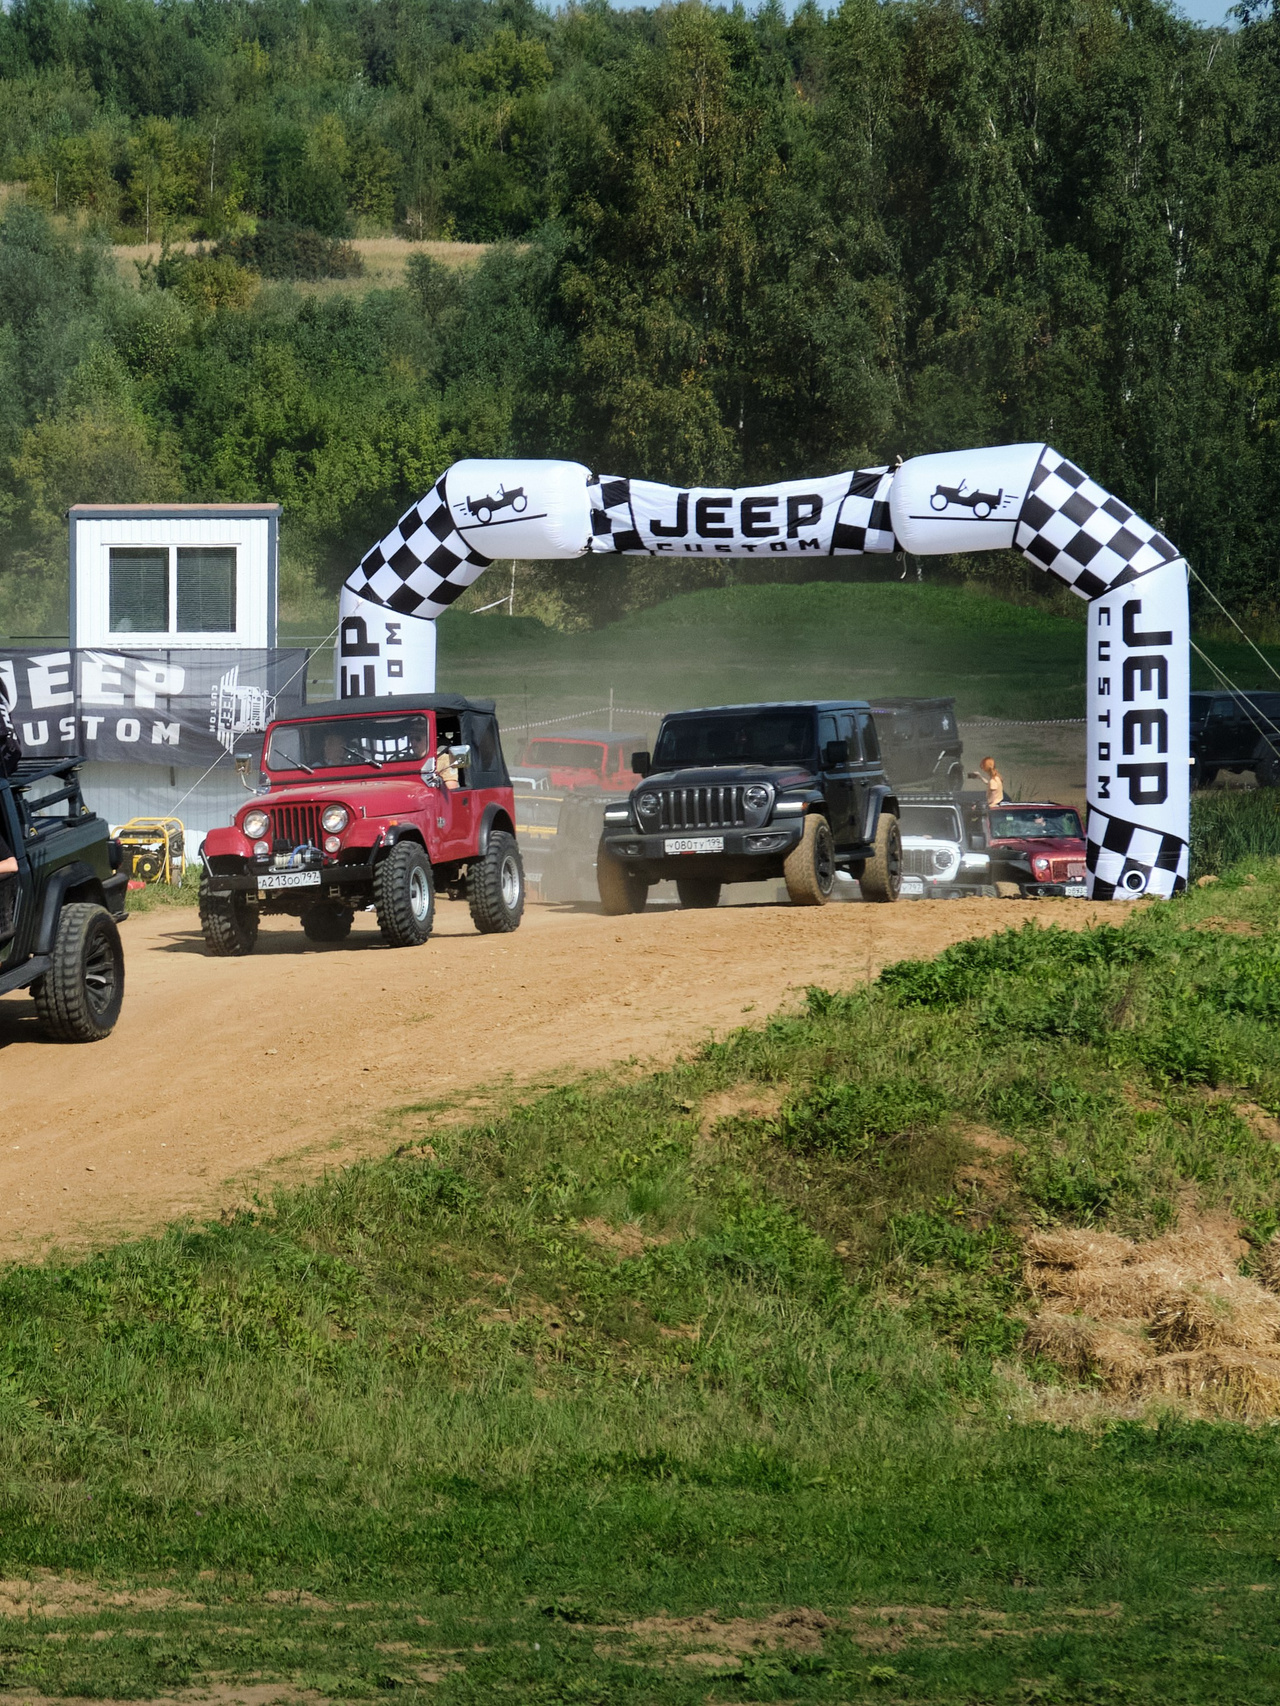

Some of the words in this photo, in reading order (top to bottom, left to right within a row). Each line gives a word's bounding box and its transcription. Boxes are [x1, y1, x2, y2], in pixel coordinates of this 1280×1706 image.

[650, 493, 823, 538] JEEP
[656, 538, 821, 552] CUSTOM
[209, 685, 218, 732] CUSTOM
[1098, 607, 1110, 798] CUSTOM
[1117, 599, 1172, 805] JEEP
[23, 716, 180, 746] USTOM
